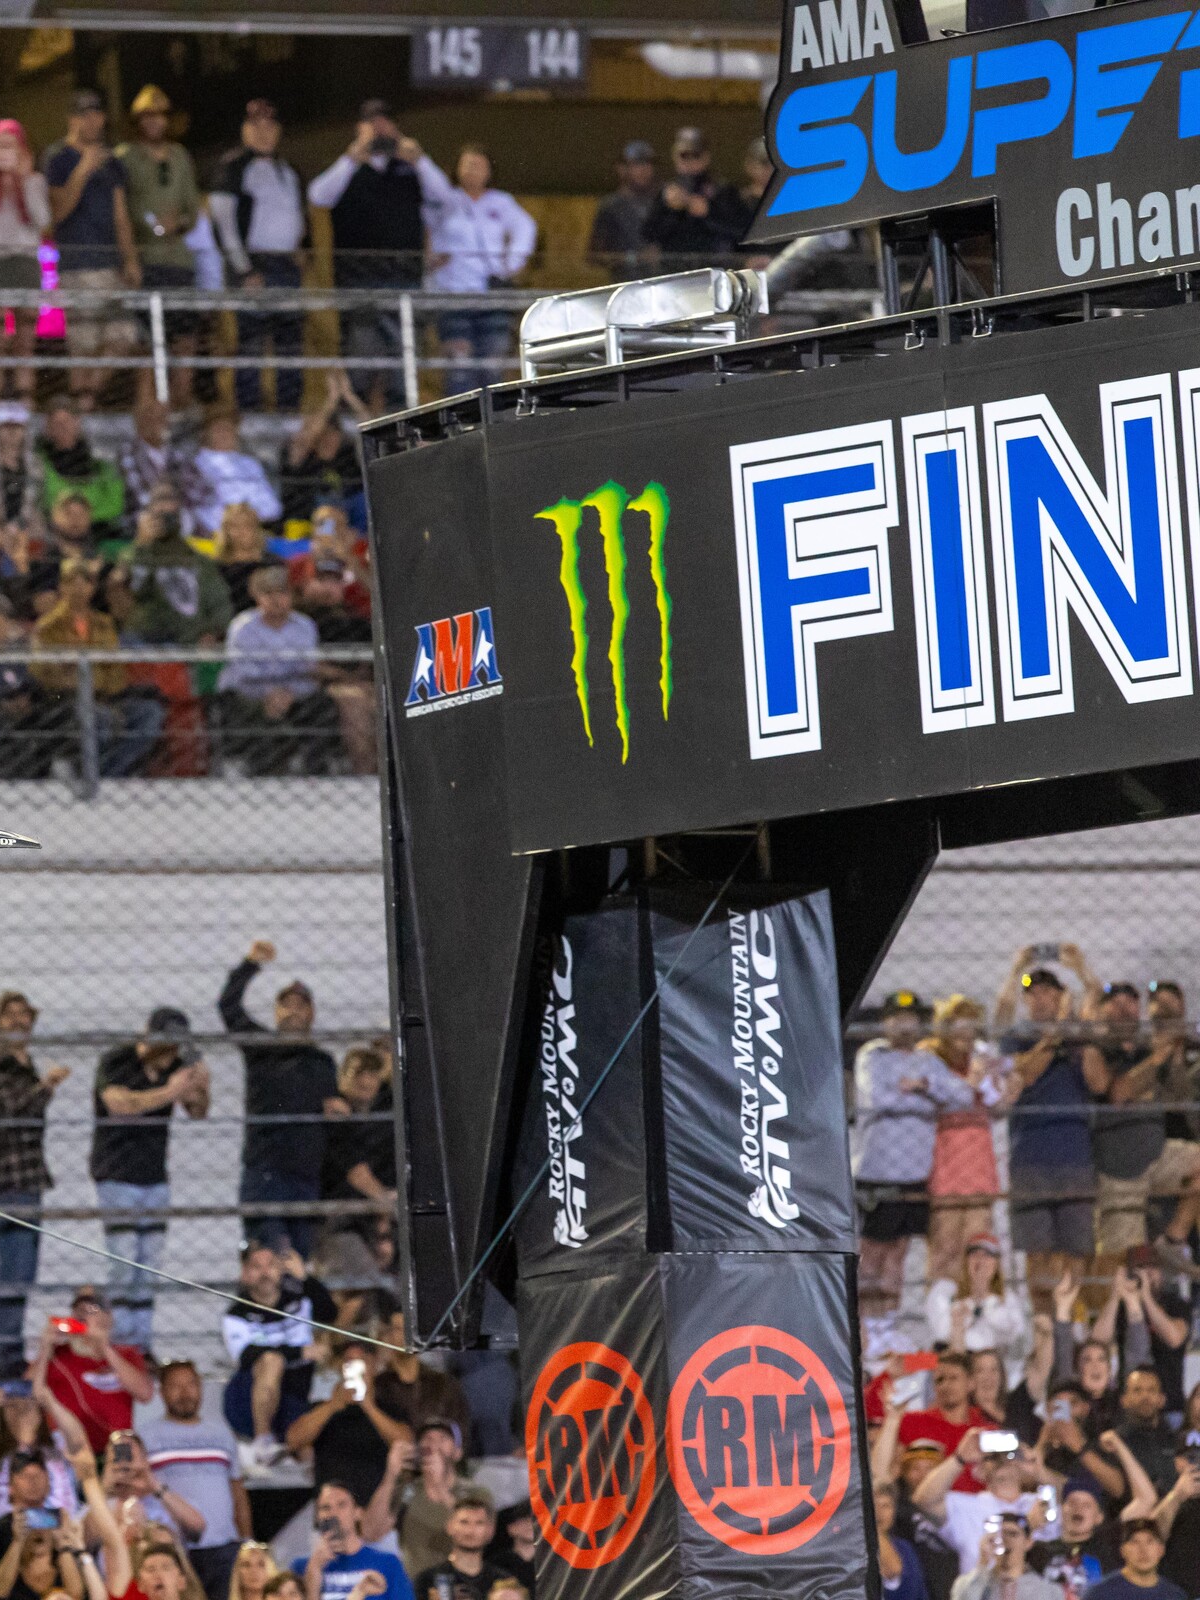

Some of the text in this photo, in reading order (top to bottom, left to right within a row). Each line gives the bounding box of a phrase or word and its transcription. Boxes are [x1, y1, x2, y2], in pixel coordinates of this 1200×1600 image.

[428, 27, 581, 79] 145 144
[789, 0, 895, 74] AMA
[767, 11, 1200, 217] SUPE
[729, 368, 1200, 760] FIN
[403, 606, 503, 707] AMA
[727, 907, 760, 1181] ROCKY MOUNTAIN
[545, 1102, 565, 1203] ROCKY
[551, 1403, 632, 1506] RM
[701, 1392, 817, 1488] RM
